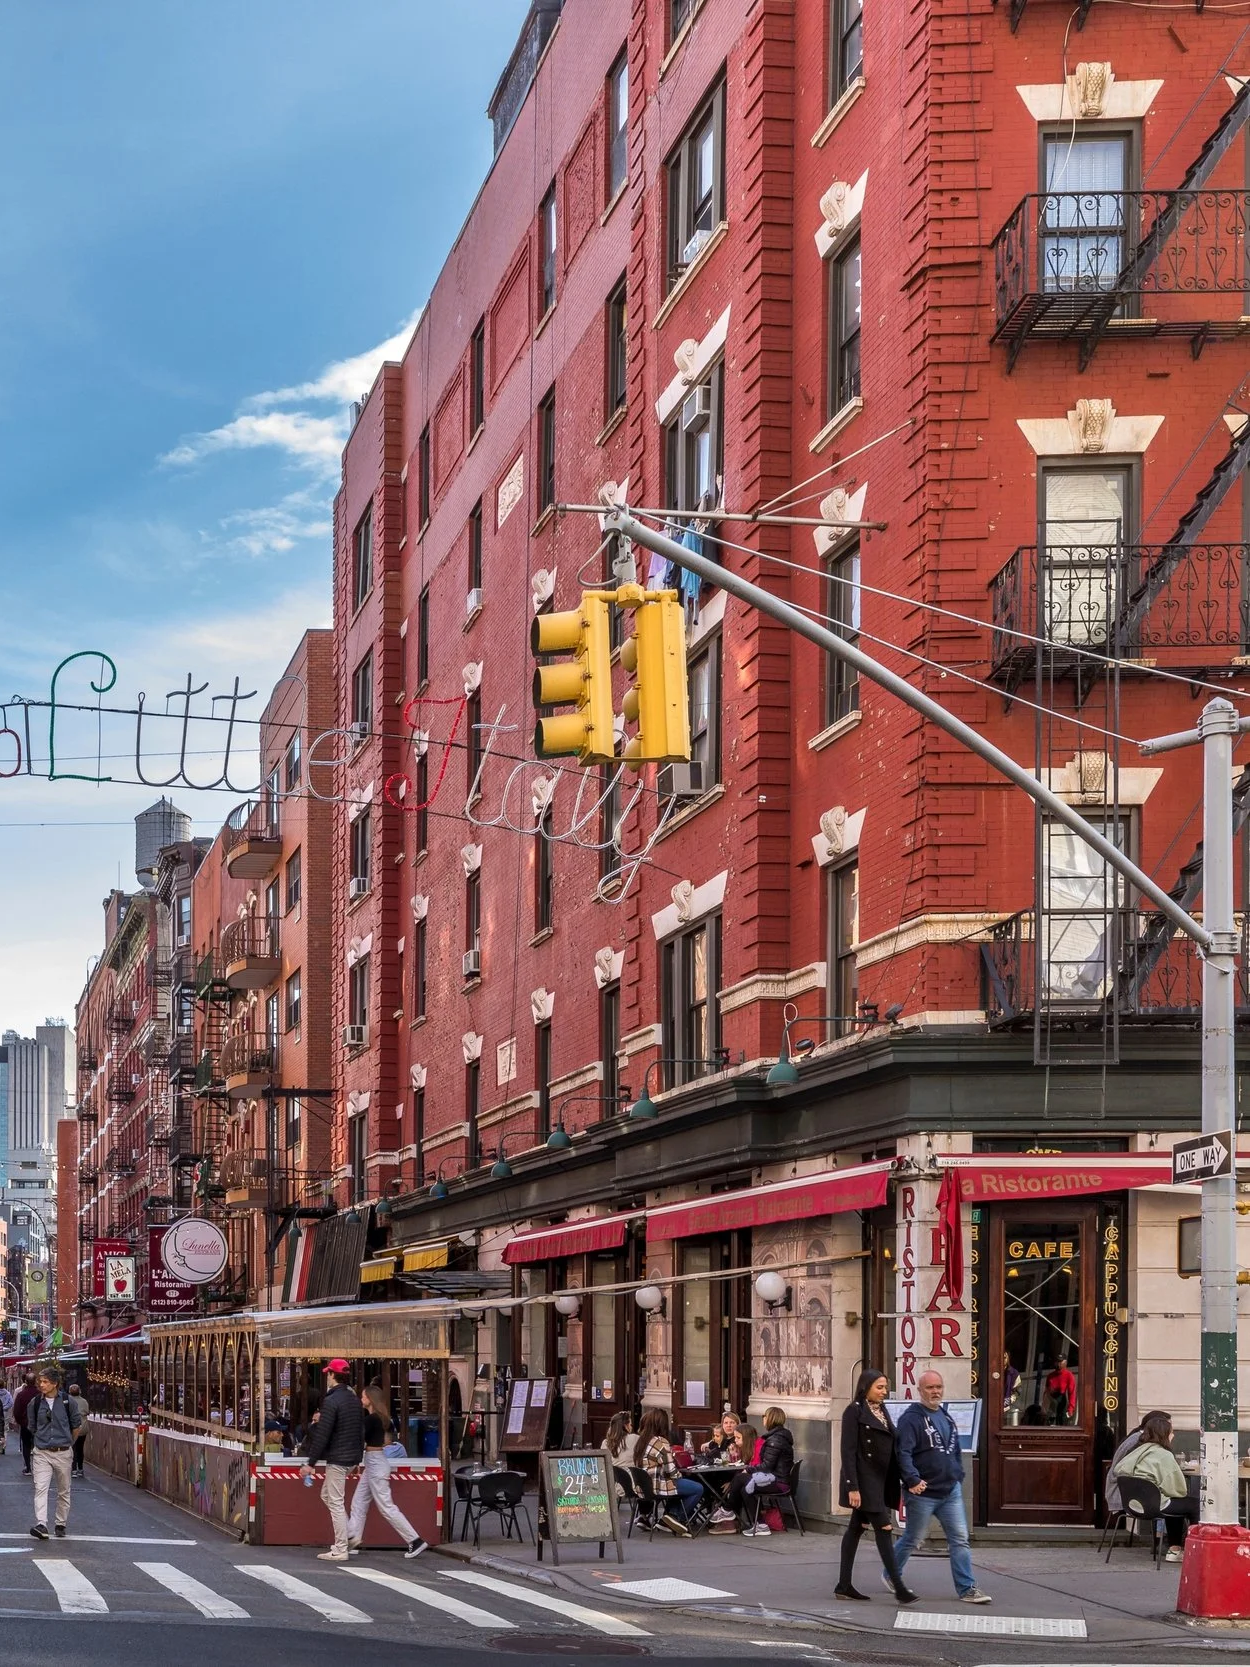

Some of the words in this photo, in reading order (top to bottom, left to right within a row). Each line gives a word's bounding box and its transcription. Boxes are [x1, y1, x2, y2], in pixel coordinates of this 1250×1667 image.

[49, 650, 355, 802] Little
[385, 696, 677, 905] Italy
[1180, 1152, 1196, 1171] ONE
[1202, 1146, 1222, 1166] WAY
[981, 1173, 1103, 1194] Ristorante
[1009, 1241, 1074, 1259] CAFE
[110, 1260, 124, 1271] LA
[110, 1267, 132, 1280] MELA
[971, 1226, 980, 1399] ESPRESS
[1104, 1226, 1119, 1411] CAPPUCCINO
[558, 1457, 598, 1476] BRUNCH
